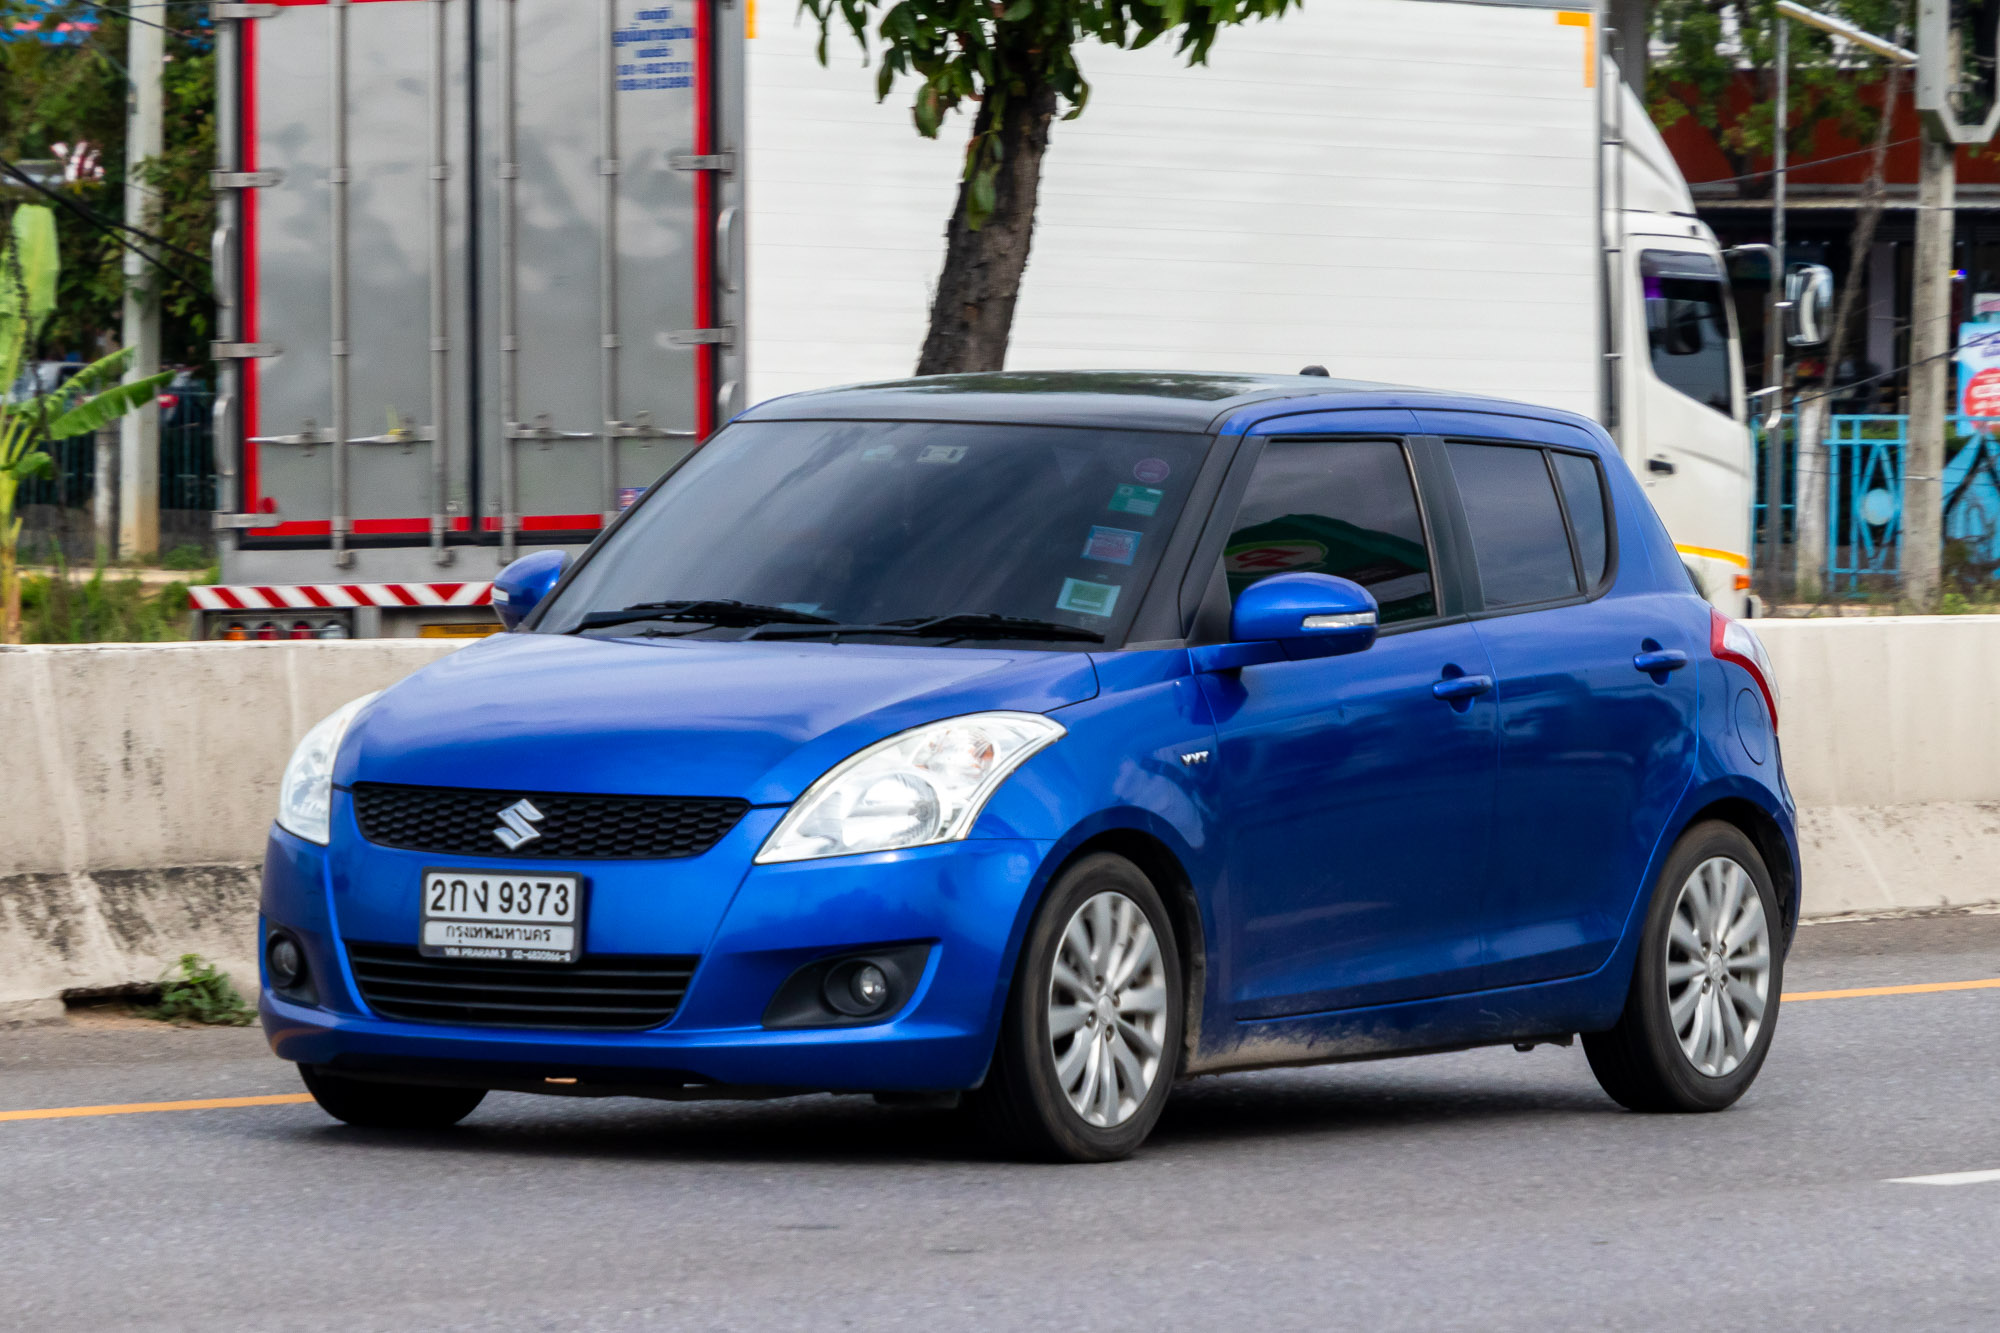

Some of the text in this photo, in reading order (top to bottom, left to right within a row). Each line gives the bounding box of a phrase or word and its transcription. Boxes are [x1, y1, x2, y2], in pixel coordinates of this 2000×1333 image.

[431, 879, 569, 916] 2กง 9373
[446, 924, 552, 944] กรุงเทพมหานคร
